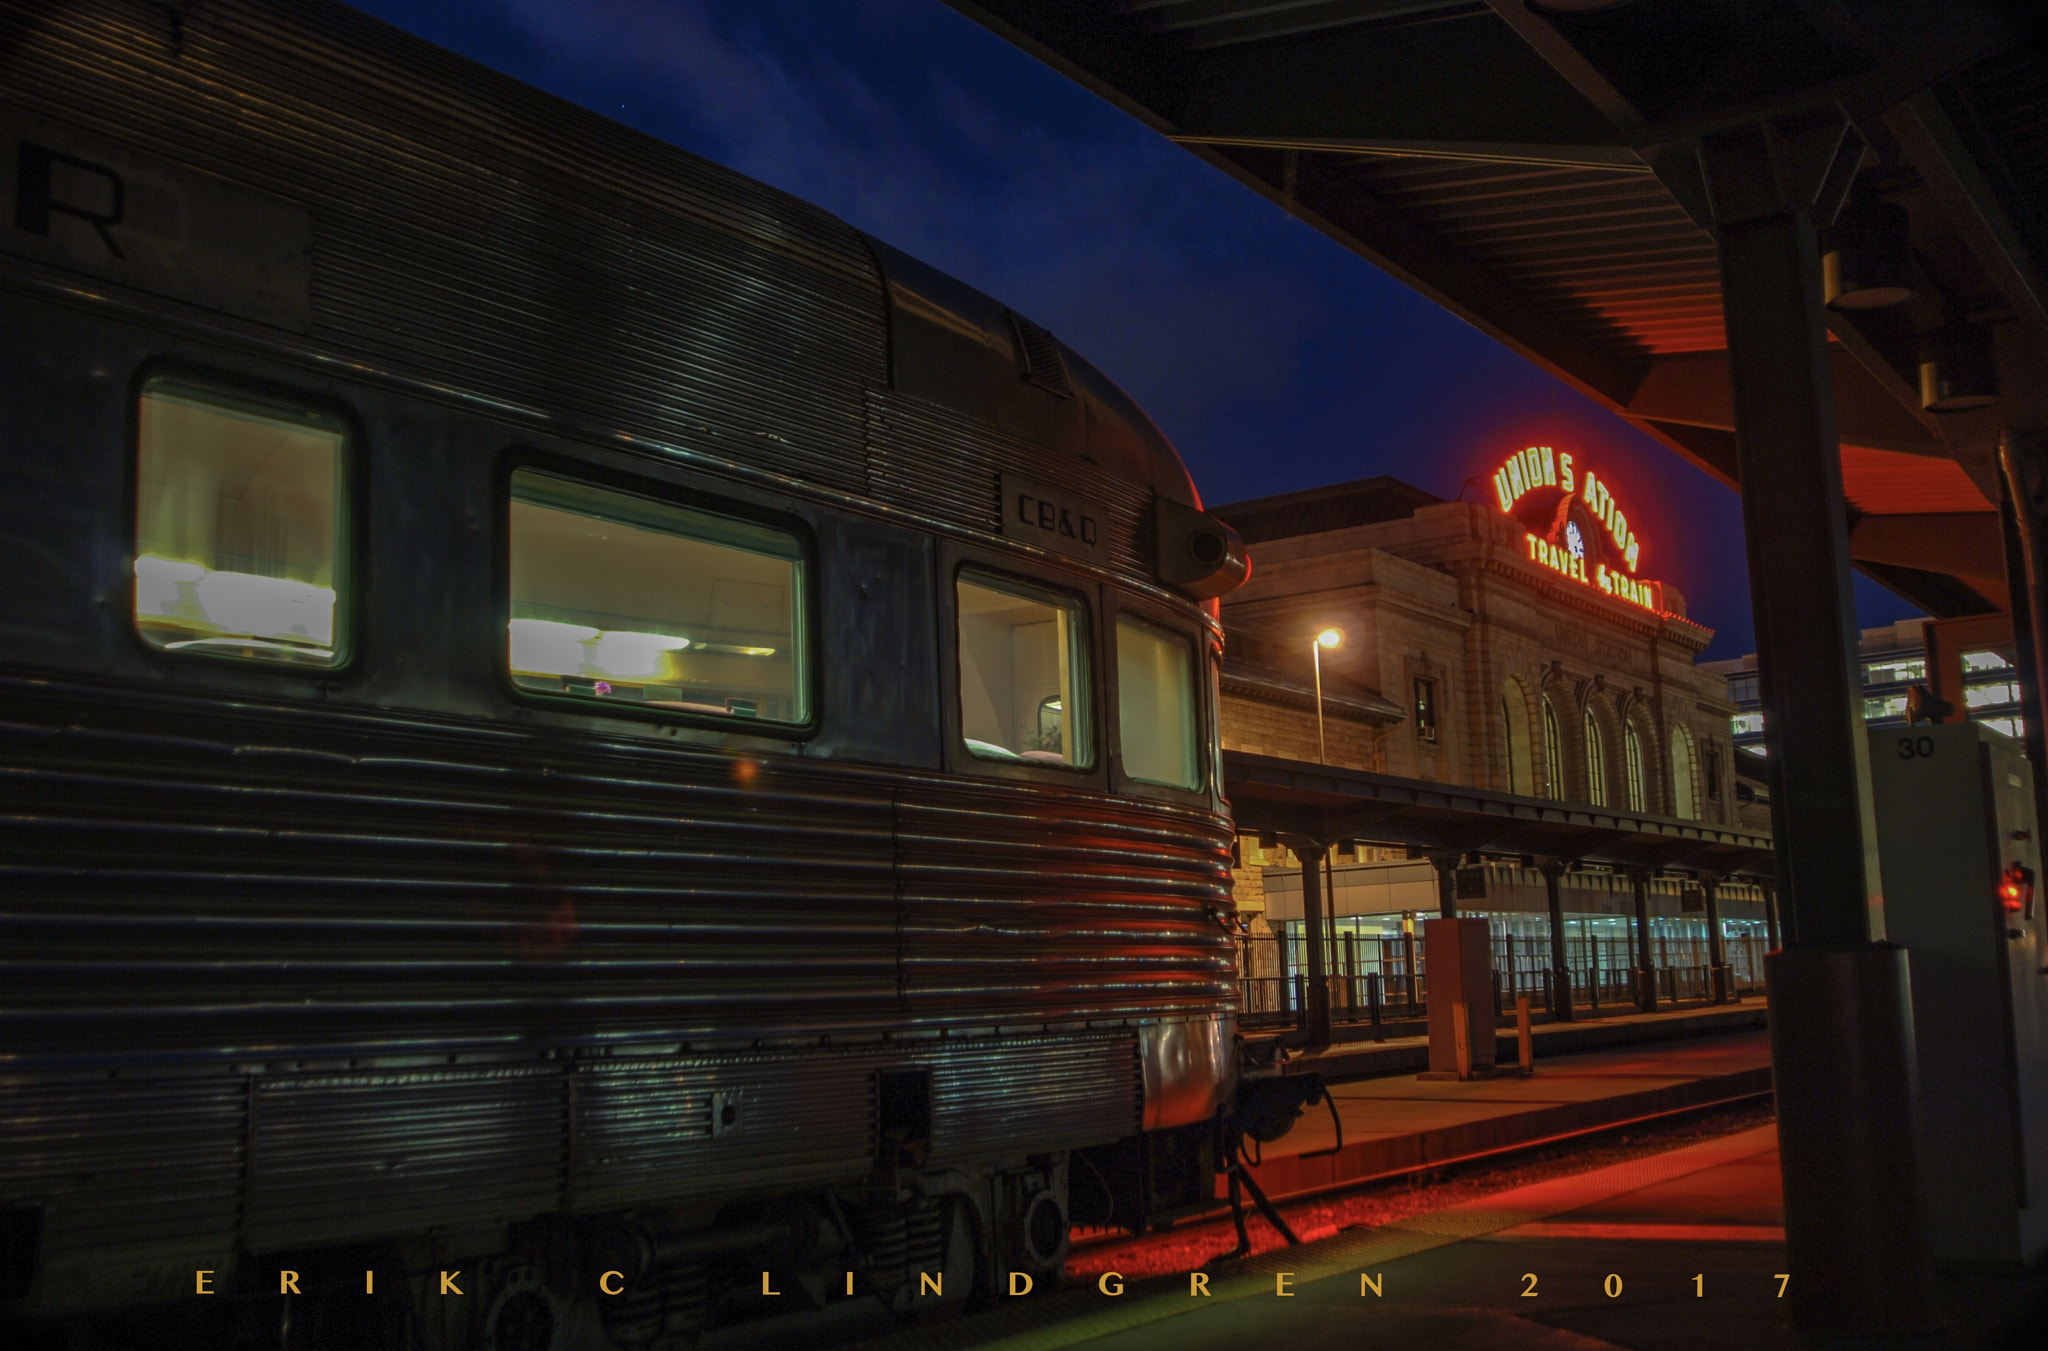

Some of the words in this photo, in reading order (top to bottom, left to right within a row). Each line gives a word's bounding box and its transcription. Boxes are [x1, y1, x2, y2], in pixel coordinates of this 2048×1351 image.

[16, 139, 125, 260] R
[1494, 446, 1557, 513] UNION
[1018, 494, 1097, 547] CB&Q
[1526, 533, 1589, 584] TRAVEL
[1610, 570, 1653, 610] TRAIN
[1898, 735, 1935, 760] 30
